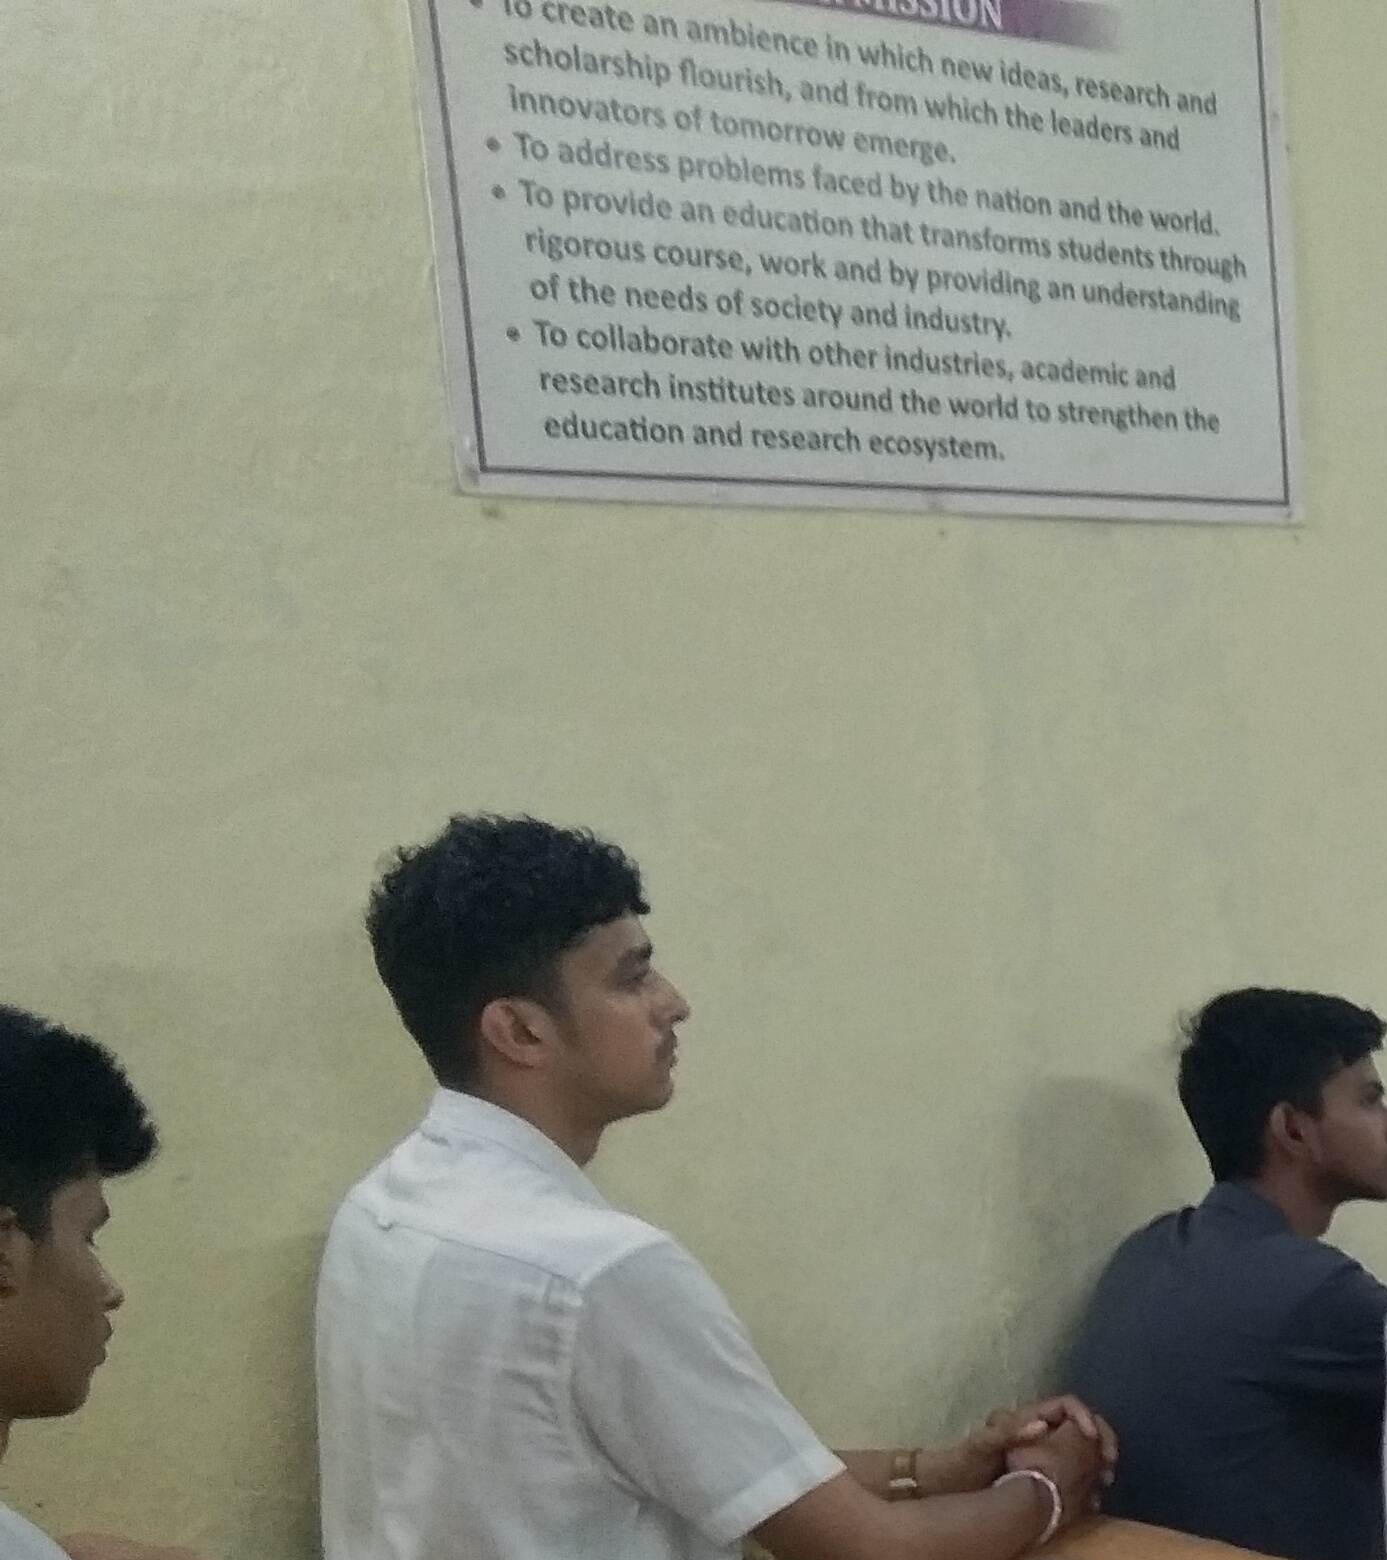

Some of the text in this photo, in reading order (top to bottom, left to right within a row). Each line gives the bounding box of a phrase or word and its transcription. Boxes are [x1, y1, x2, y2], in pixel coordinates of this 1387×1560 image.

[504, 38, 1181, 151] scholarship flourish, and from which the leaders and
[541, 2, 634, 32] create
[644, 13, 678, 38] an
[686, 18, 819, 58] ambience
[826, 33, 850, 63] in
[857, 40, 934, 74] which
[941, 59, 993, 83] new
[1000, 60, 1068, 98] ideas,
[1075, 76, 1171, 109] research
[1177, 92, 1218, 116] and
[508, 83, 956, 166] innovators of tomorrow emerge.
[513, 131, 1219, 237] To address problems faced by the nation and the world.
[518, 178, 1247, 283] To provide an education that transforms students through
[525, 229, 1241, 323] rigorous course, work and by providing an understanding
[529, 272, 1012, 342] of the needs of society and industry.
[532, 318, 1176, 390] To collaborate with other industries, academic and
[539, 369, 1220, 434] research institutes around the world to strengthen the
[544, 410, 1006, 463] education and research ecosystem.
